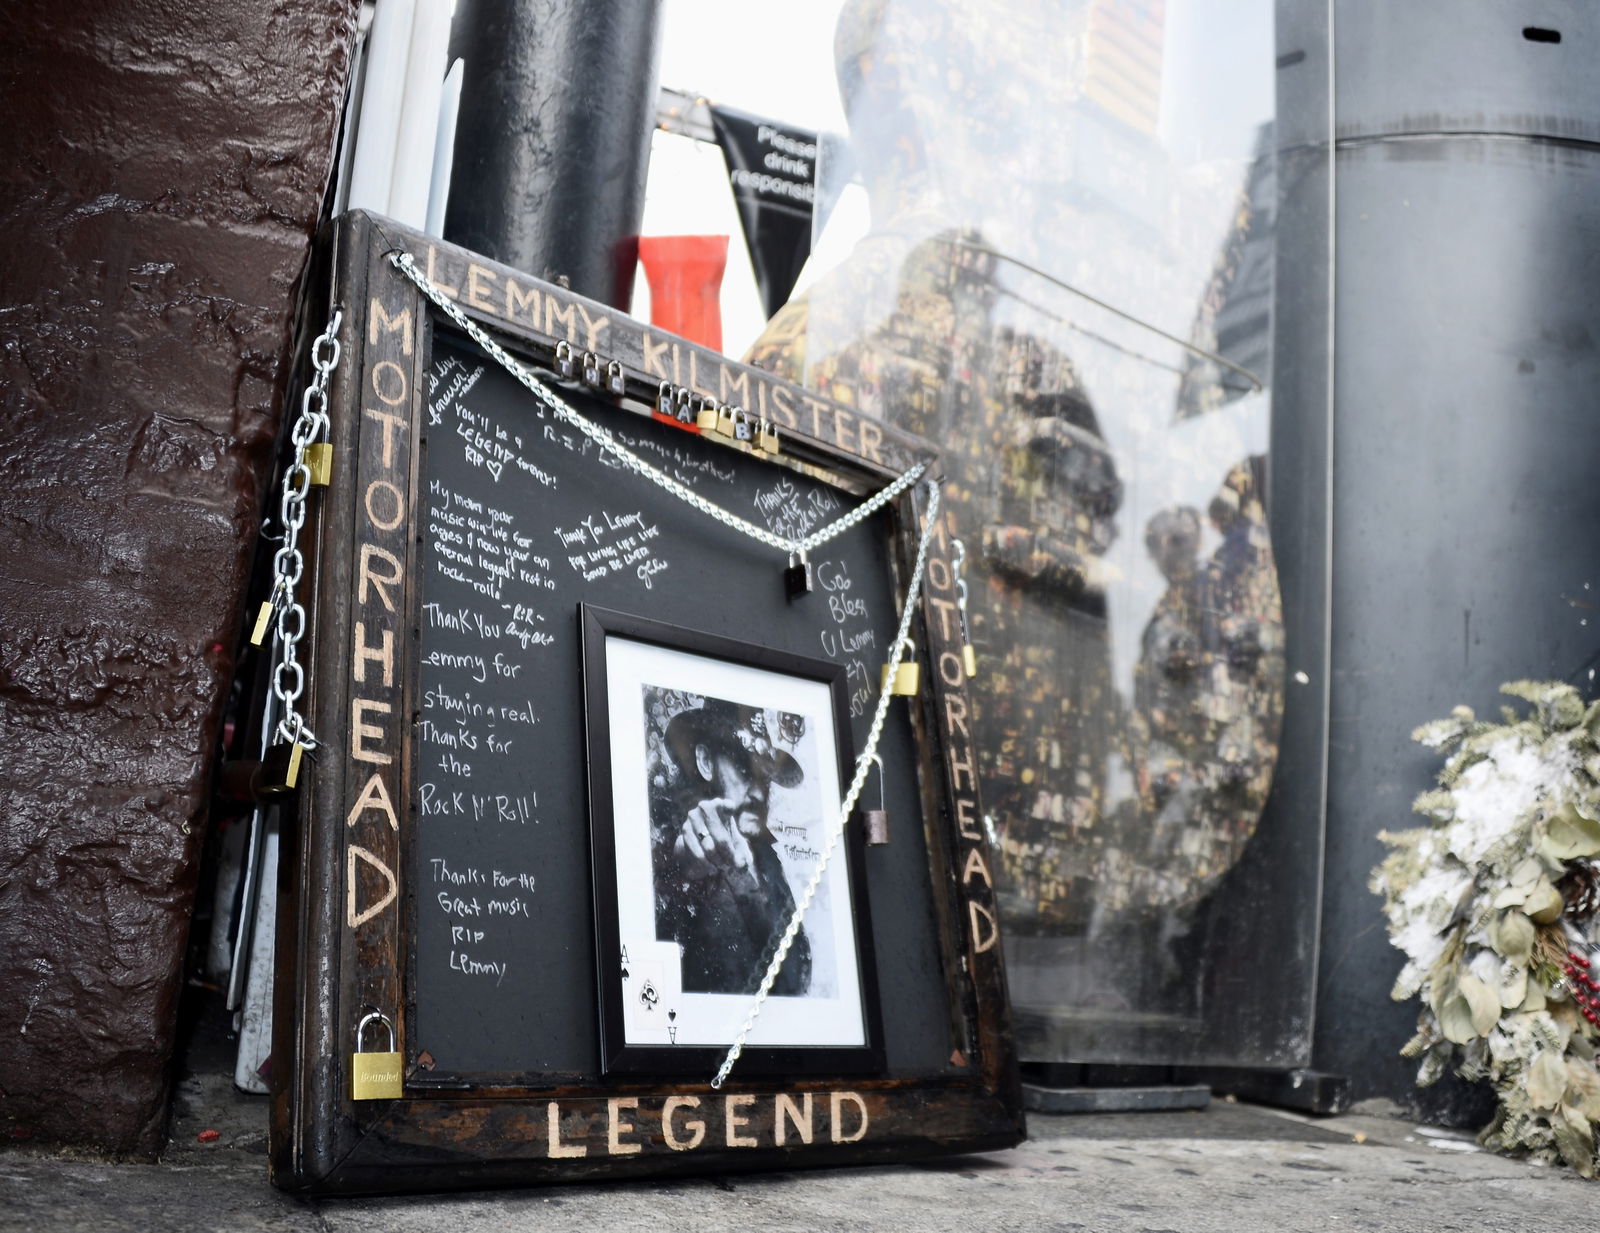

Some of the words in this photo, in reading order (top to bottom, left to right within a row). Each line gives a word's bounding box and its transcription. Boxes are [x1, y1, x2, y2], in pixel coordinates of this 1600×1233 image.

[757, 125, 817, 159] Please
[764, 151, 809, 178] drink
[427, 245, 610, 353] LEMMY
[642, 332, 883, 458] KILMISTER
[456, 423, 515, 464] LEGEND
[429, 479, 450, 510] My
[430, 507, 465, 527] music
[477, 537, 500, 554] now
[520, 569, 541, 587] rest
[544, 576, 555, 590] in
[347, 297, 412, 928] MOTORHEAD
[422, 602, 473, 634] Thank
[473, 613, 500, 639] You
[492, 653, 521, 679] for
[420, 720, 478, 750] Thanks
[486, 734, 513, 755] for
[438, 754, 471, 777] the
[418, 783, 465, 816] Rock
[495, 791, 540, 824] Roll!
[437, 892, 481, 918] Great
[547, 1091, 869, 1159] LEGEND
